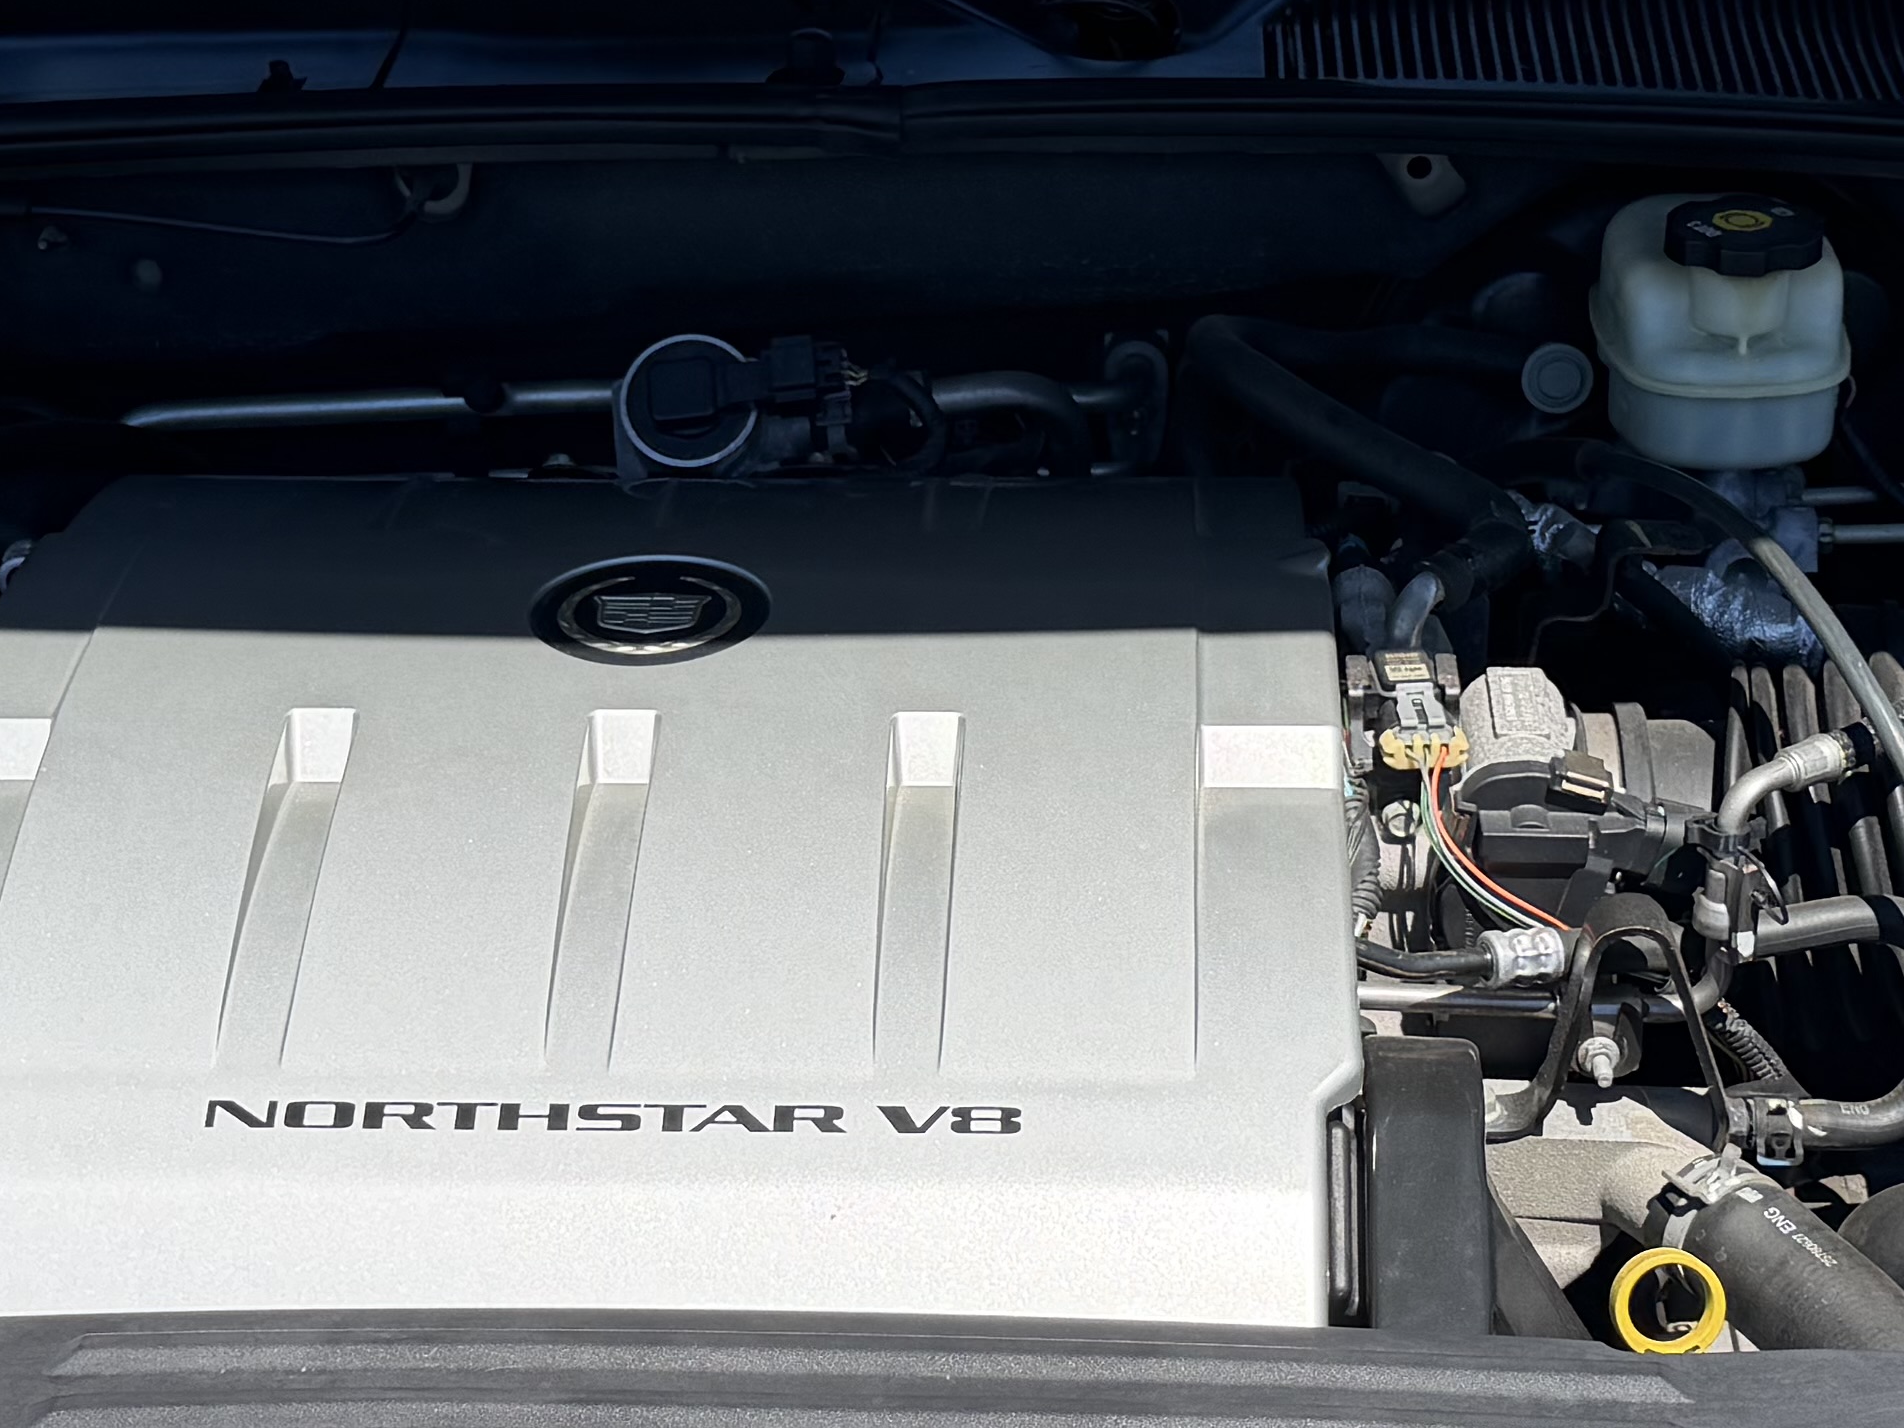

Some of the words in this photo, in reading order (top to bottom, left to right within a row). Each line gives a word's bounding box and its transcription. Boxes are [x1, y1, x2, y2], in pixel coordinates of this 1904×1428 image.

[204, 1098, 848, 1135] NORTHSTAR
[876, 1104, 1024, 1136] V8
[1764, 1207, 1797, 1234] ENG
